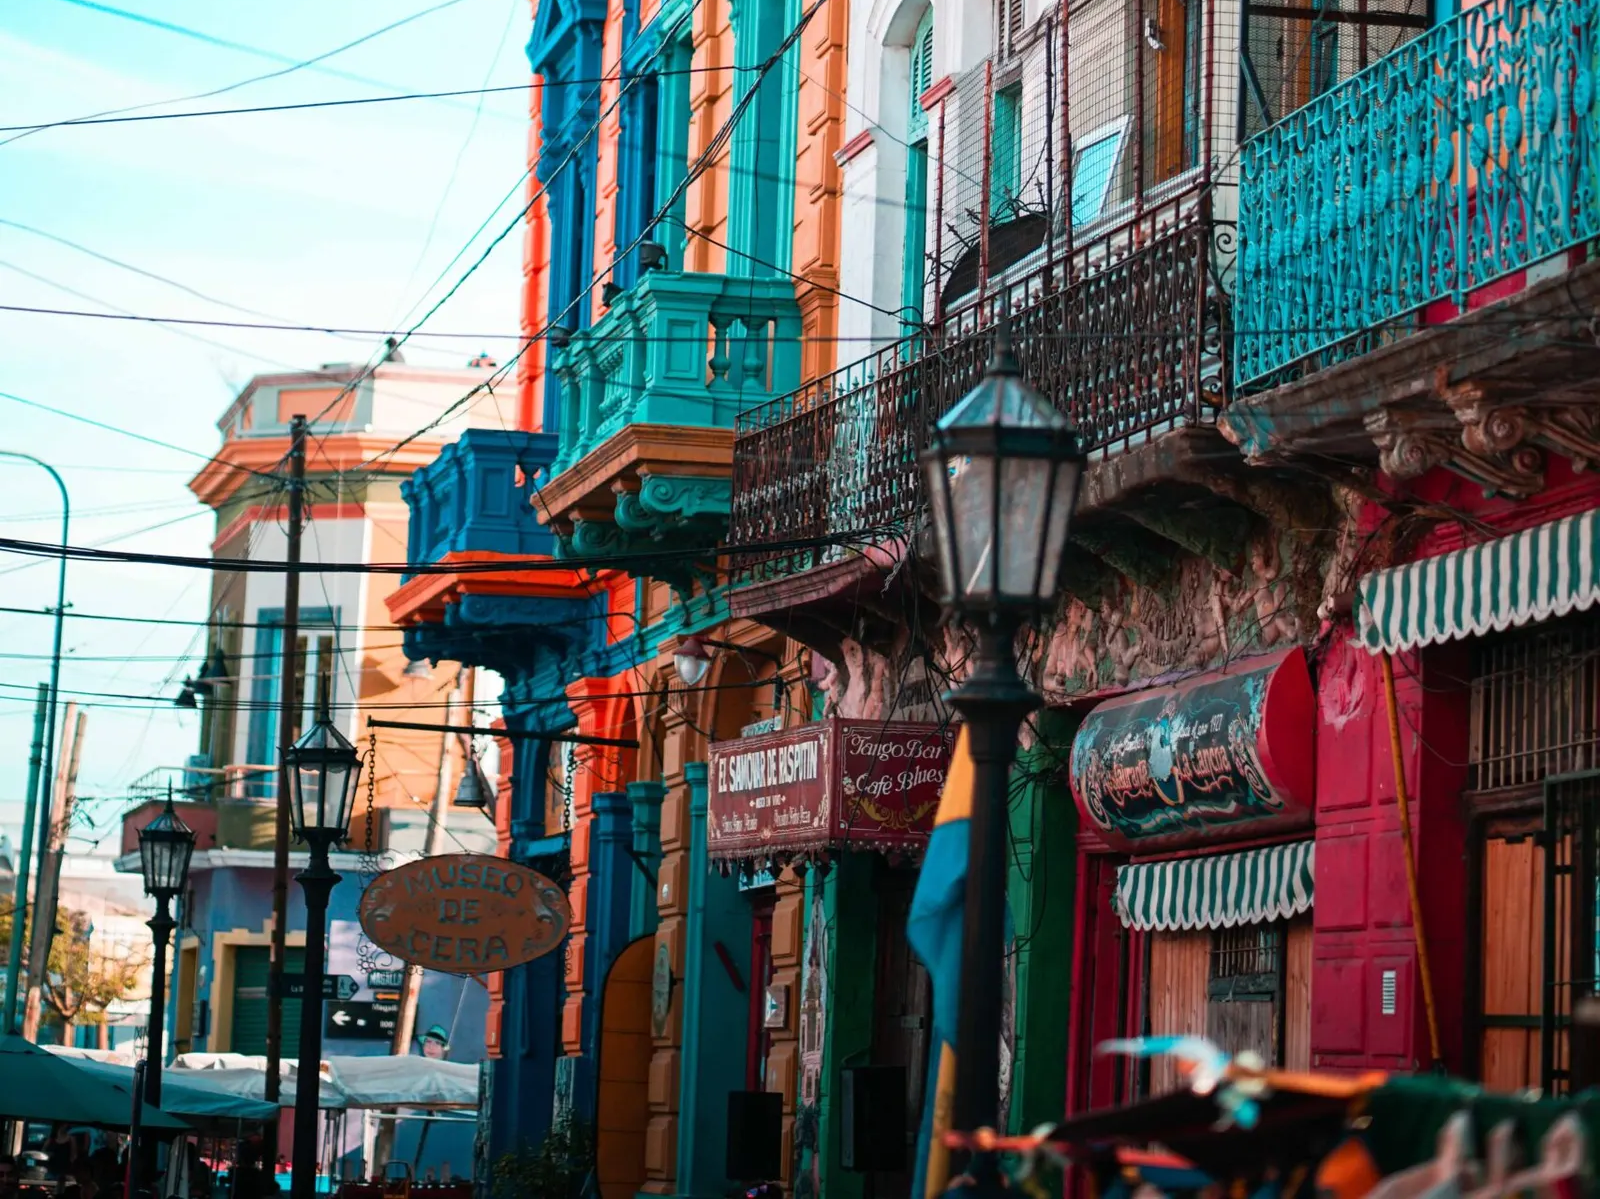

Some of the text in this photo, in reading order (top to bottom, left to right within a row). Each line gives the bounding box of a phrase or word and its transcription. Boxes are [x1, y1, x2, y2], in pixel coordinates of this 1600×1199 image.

[849, 734, 946, 761] Tango Bar
[717, 740, 818, 793] EL SAMOVAR DE RASPUTIN
[856, 765, 944, 798] Café Blues
[404, 864, 523, 898] MUSEO
[438, 898, 481, 925] DE
[406, 924, 509, 964] CERA
[370, 971, 403, 986] MAGALLA
